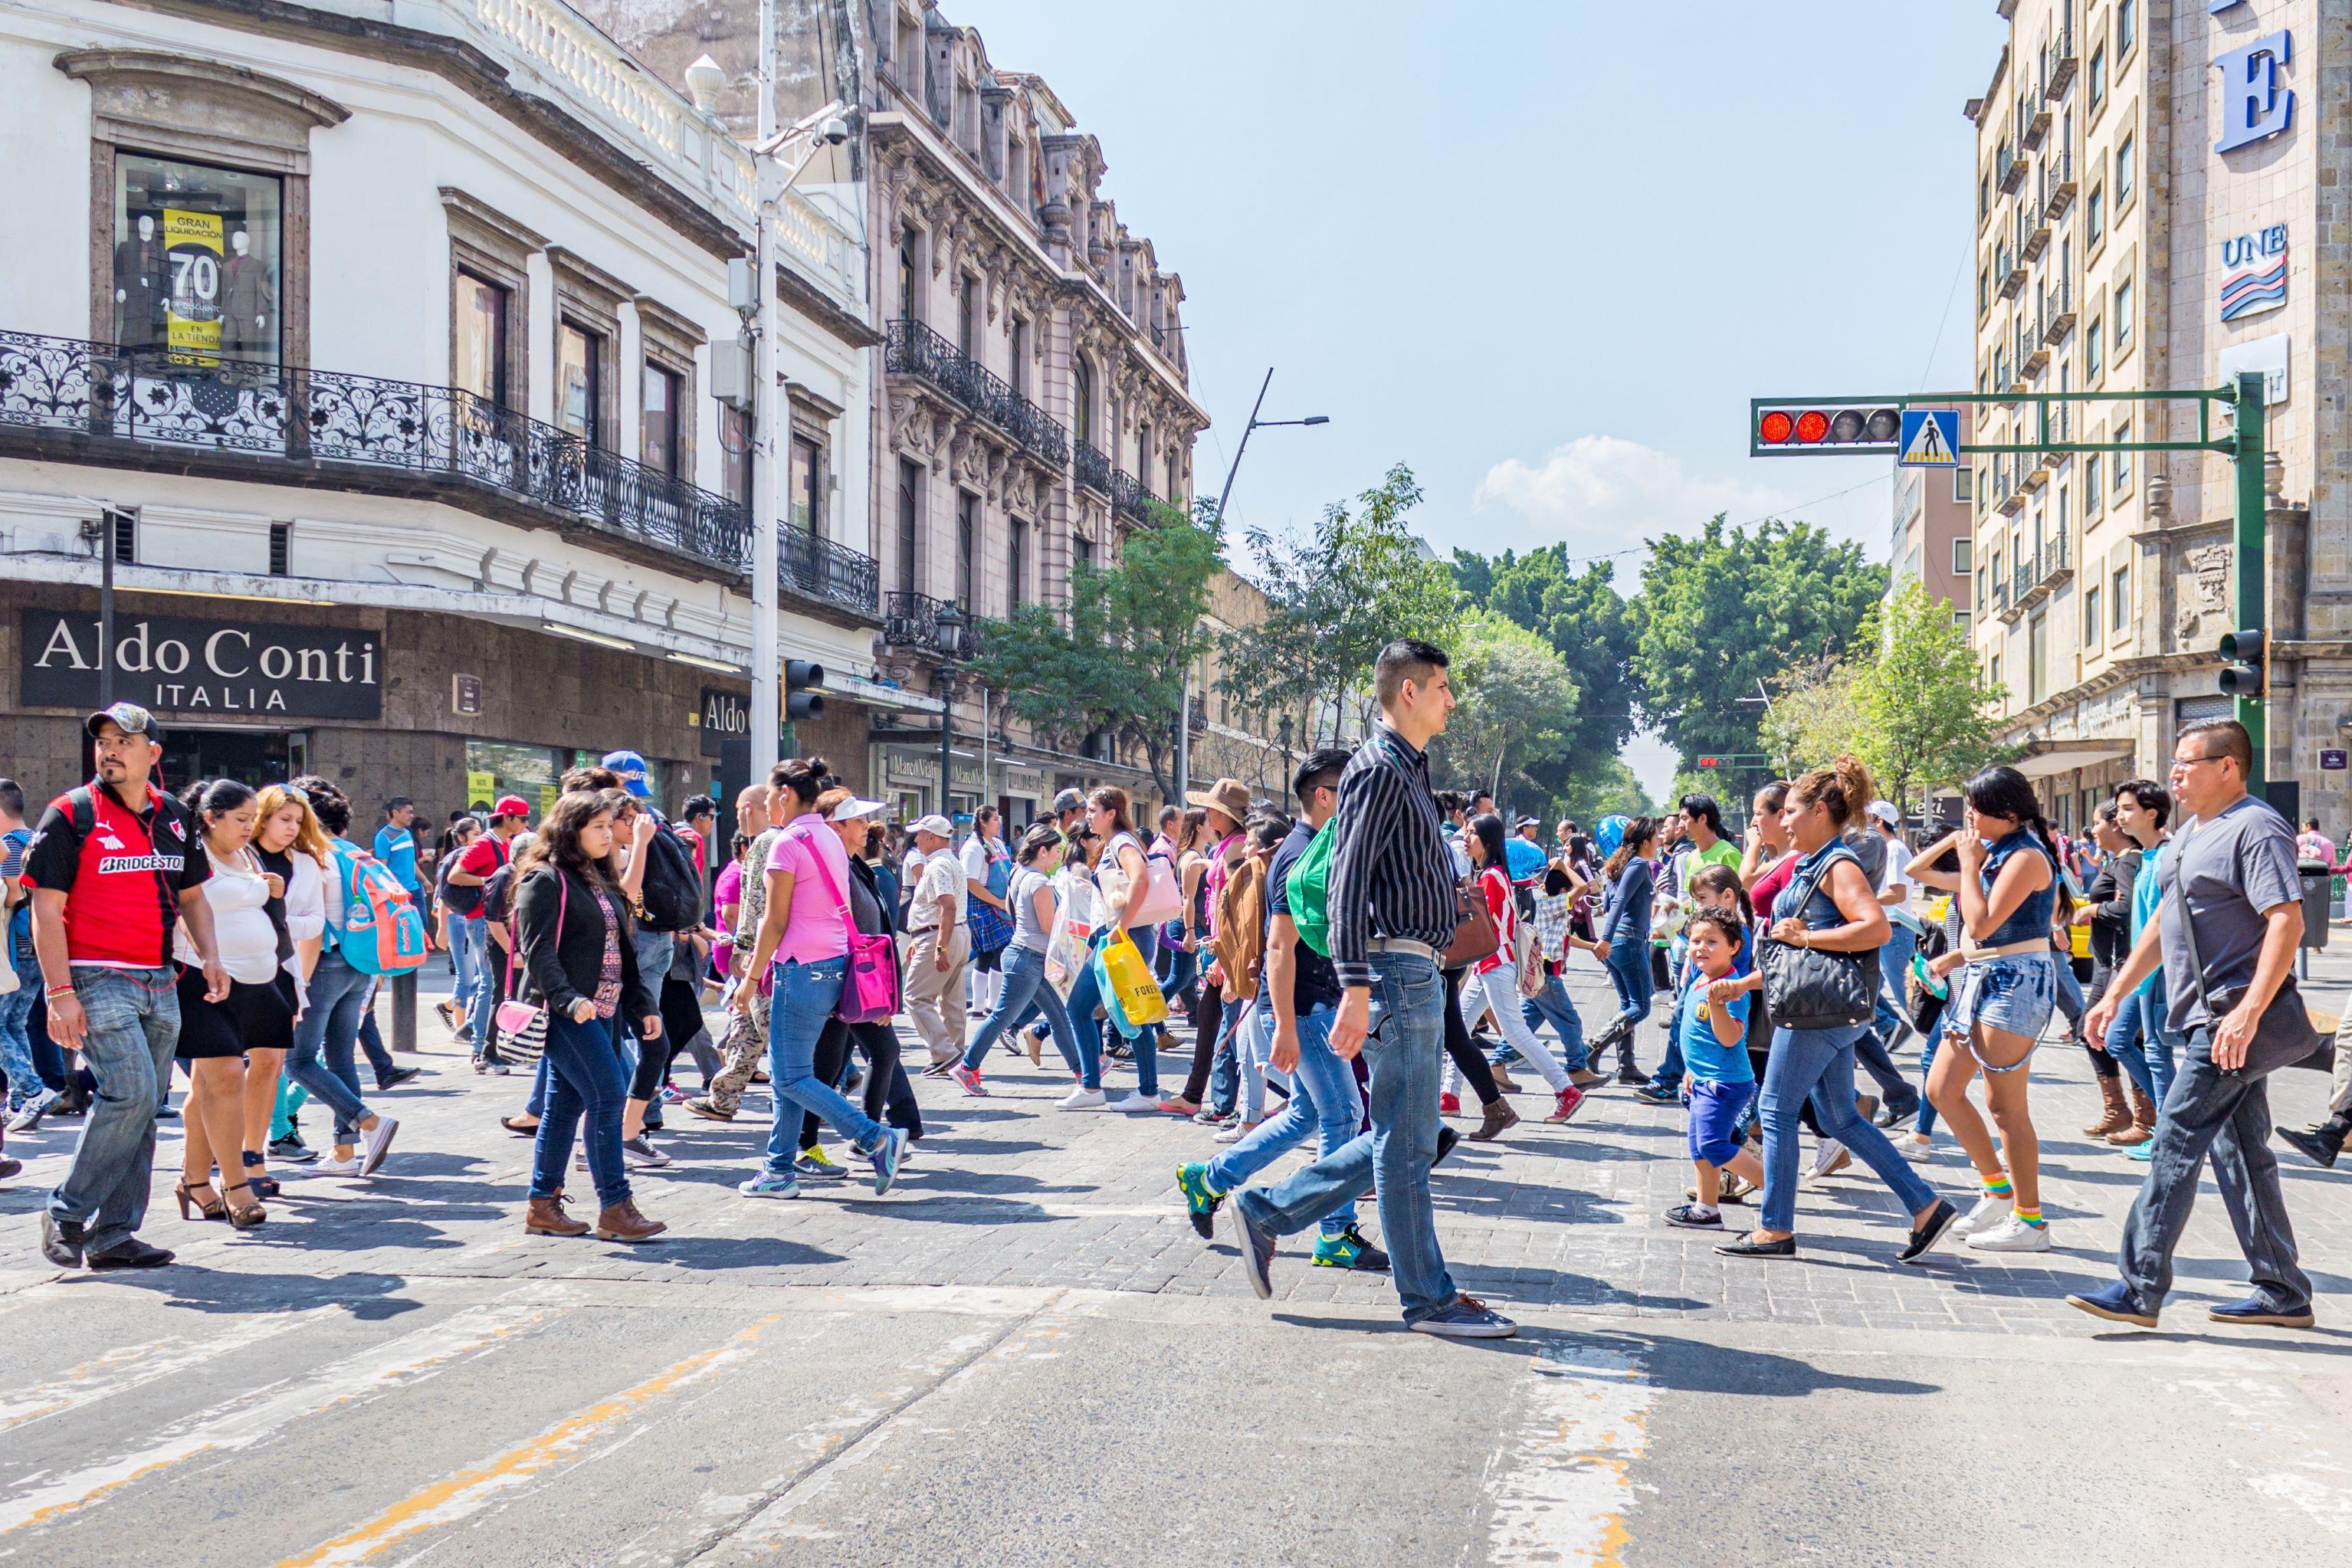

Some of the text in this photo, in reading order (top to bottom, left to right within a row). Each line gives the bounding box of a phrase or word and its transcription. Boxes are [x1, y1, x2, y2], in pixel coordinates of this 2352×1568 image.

[177, 217, 211, 229] GRAN
[2221, 222, 2287, 267] UNE
[172, 332, 184, 340] LA
[191, 325, 203, 333] EN
[34, 618, 377, 684] Aldo Conti
[156, 684, 287, 711] ITALIA
[705, 694, 746, 733] Aldo
[894, 754, 918, 776] Marco
[955, 764, 975, 785] Marco
